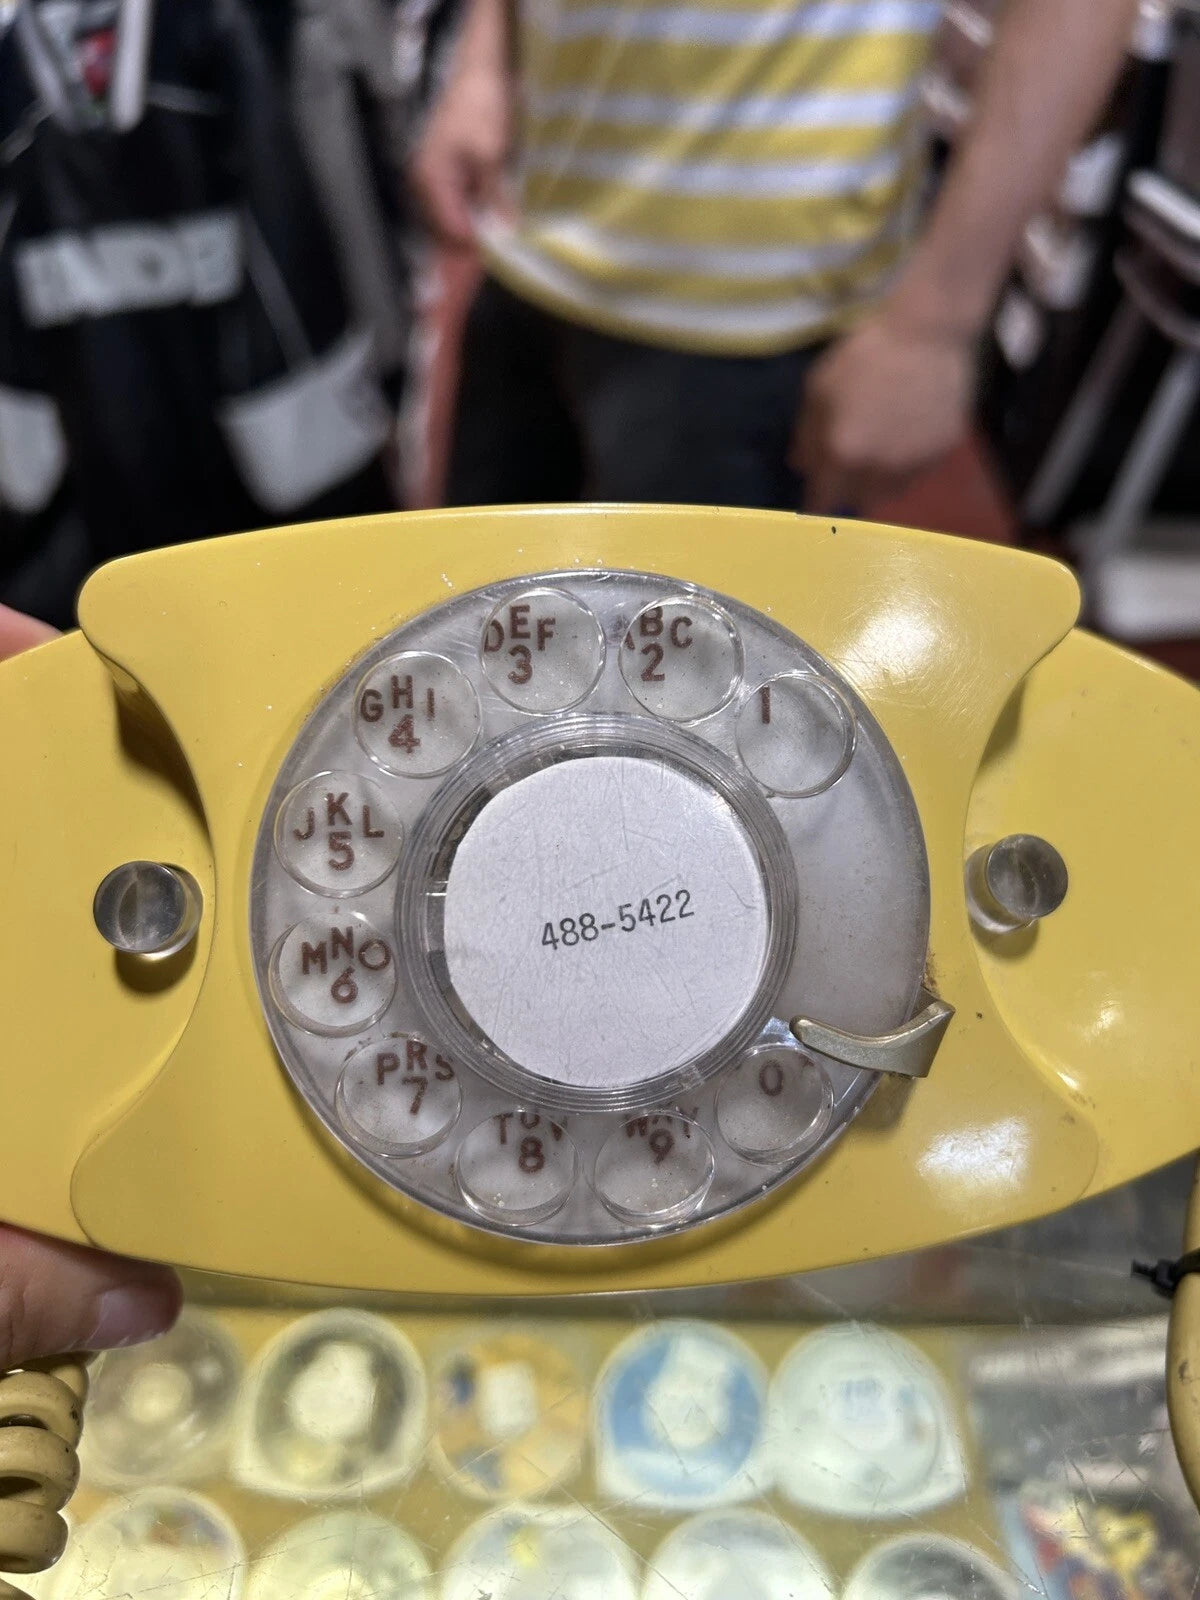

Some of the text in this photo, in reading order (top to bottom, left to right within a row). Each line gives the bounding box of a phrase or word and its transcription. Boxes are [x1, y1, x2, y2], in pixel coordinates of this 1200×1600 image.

[483, 604, 556, 651] DEF
[507, 645, 533, 684] 3
[640, 642, 665, 681] 2
[360, 675, 435, 722] GHI
[388, 714, 420, 754] 4
[293, 792, 385, 841] JKL
[328, 831, 355, 871] 5
[541, 889, 695, 951] 488-5422
[300, 926, 392, 975] MNO
[330, 967, 358, 1004] 6
[376, 1040, 455, 1086] PRS
[402, 1076, 428, 1115] 7
[519, 1135, 545, 1174] 8
[649, 1127, 675, 1168] 9
